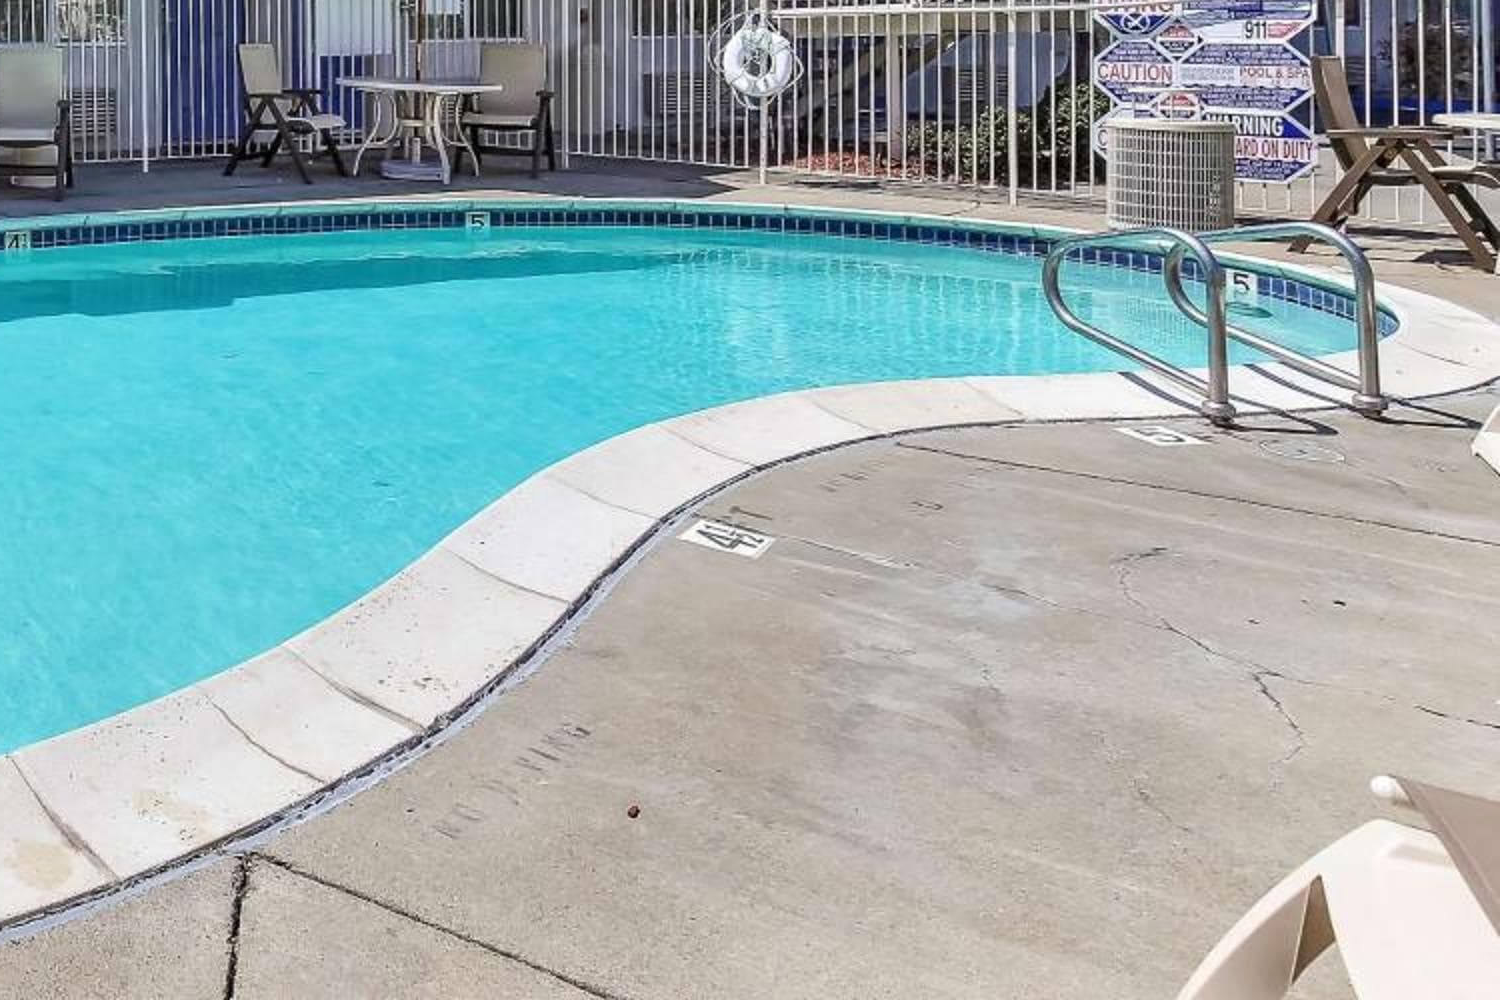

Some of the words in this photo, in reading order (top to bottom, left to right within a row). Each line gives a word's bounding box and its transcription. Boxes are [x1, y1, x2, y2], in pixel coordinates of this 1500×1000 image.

[1245, 21, 1267, 39] 911
[1097, 63, 1173, 84] CAUTION
[1239, 66, 1272, 79] POOL
[1288, 67, 1309, 78] SPA
[1262, 139, 1279, 157] ON
[1284, 140, 1313, 160] DUTY
[470, 215, 485, 229] 5
[1233, 273, 1250, 291] 5
